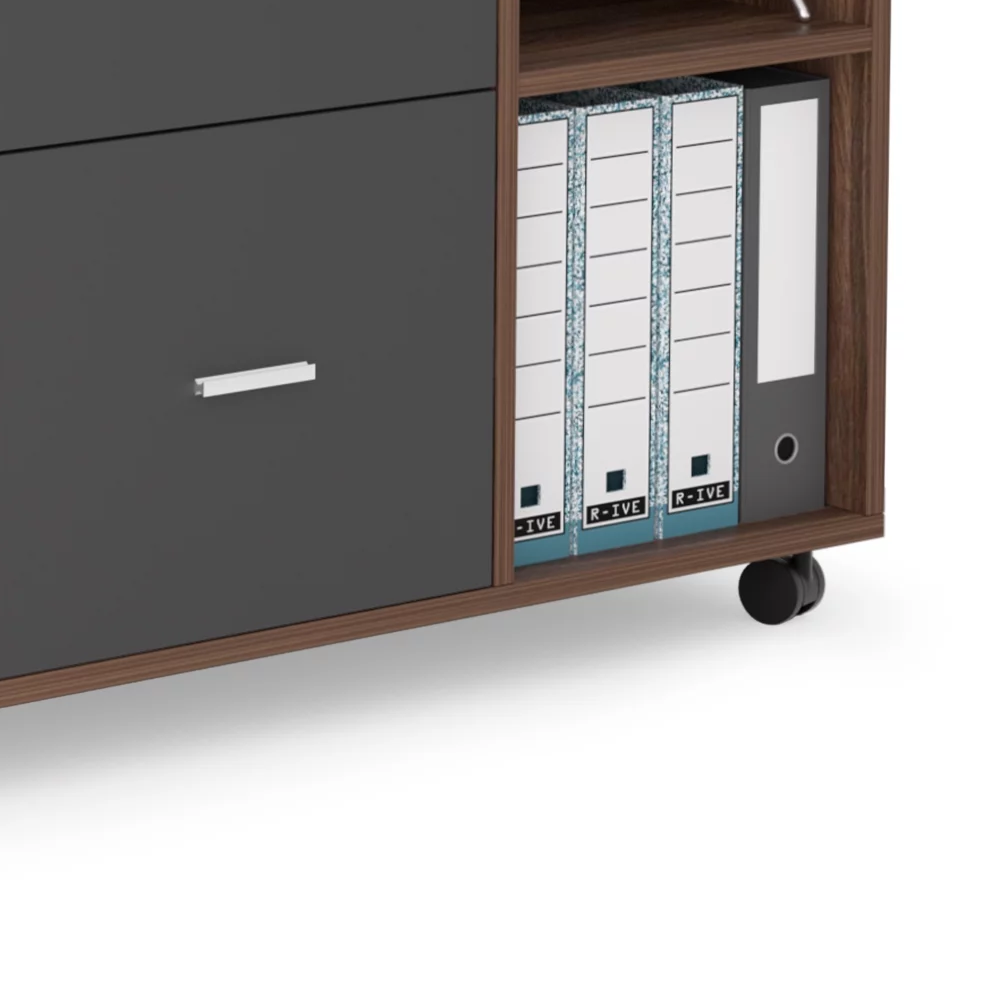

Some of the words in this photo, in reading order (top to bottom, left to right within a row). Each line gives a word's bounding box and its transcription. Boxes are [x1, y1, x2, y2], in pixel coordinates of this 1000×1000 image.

[675, 484, 725, 506] R-IVE
[590, 500, 641, 522] R-IVE
[515, 515, 556, 534] -IVE
